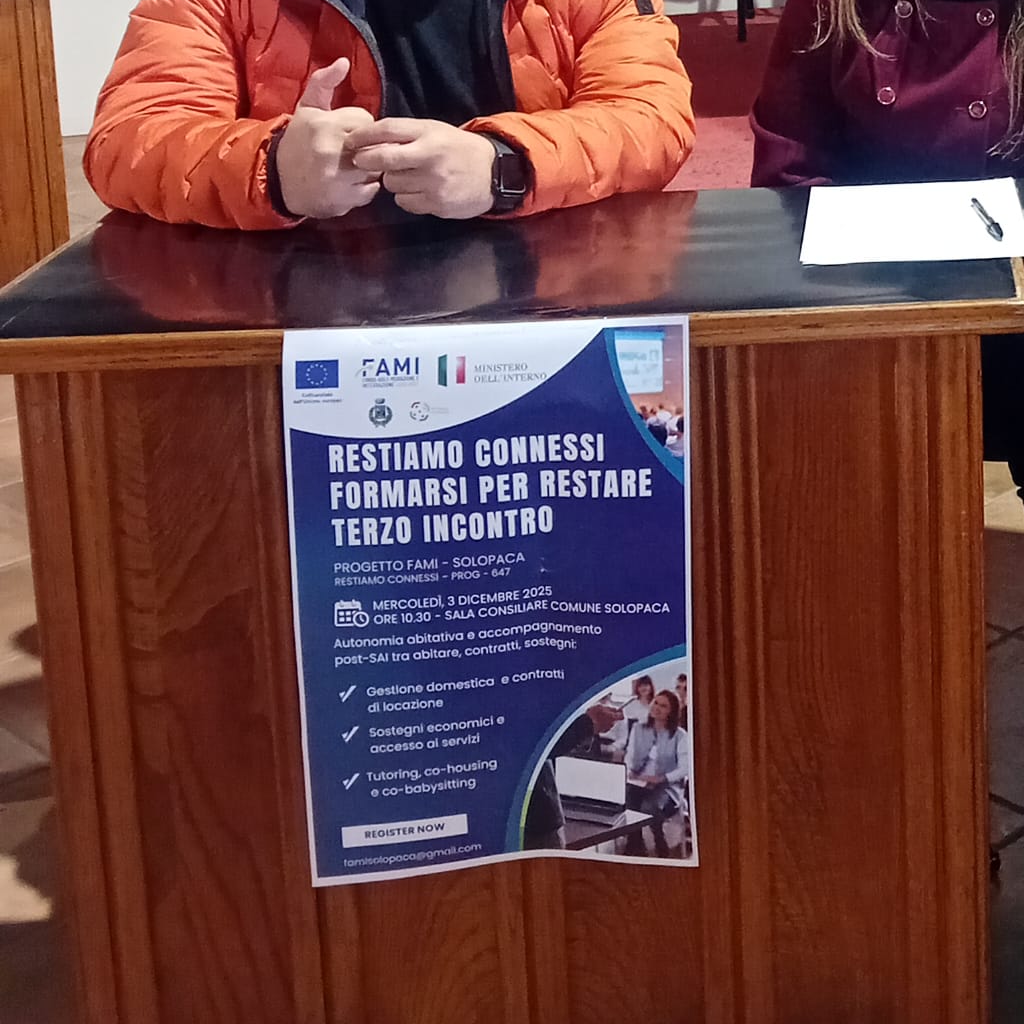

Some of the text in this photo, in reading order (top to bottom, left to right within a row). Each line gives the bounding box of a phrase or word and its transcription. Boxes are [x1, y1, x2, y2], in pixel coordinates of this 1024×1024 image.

[362, 357, 419, 376] FAMI
[474, 364, 528, 372] MINISTERO
[474, 373, 547, 383] DELL'INTERNO
[328, 434, 604, 473] RESTIAMO CONNESSI
[330, 469, 652, 509] FORMARSI PER RESTARE
[332, 506, 553, 546] TERZO INCONTRO
[334, 552, 525, 574] PROGETTO FAMI SOLOPACA
[447, 596, 455, 605] 3
[458, 590, 520, 605] DICEMBRE
[522, 586, 552, 598] 2025
[373, 600, 670, 625] ORE 10.30 SALA CONSILIARE COMUNE SOLOPACA
[334, 621, 602, 649] Autonomia abitativa e accompagnamento
[334, 635, 577, 667] post-SAI tra abitare, contratti, sostegni:
[366, 668, 564, 698] Gestione domestica e contratti
[367, 697, 443, 714] di locazione
[369, 715, 505, 740] Sostegni economici e
[370, 732, 480, 754] accesso ai servizi
[367, 758, 498, 784] Tutoring, co-housing
[371, 777, 476, 797] e co-babysitting
[364, 822, 445, 839] REGISTER NOW
